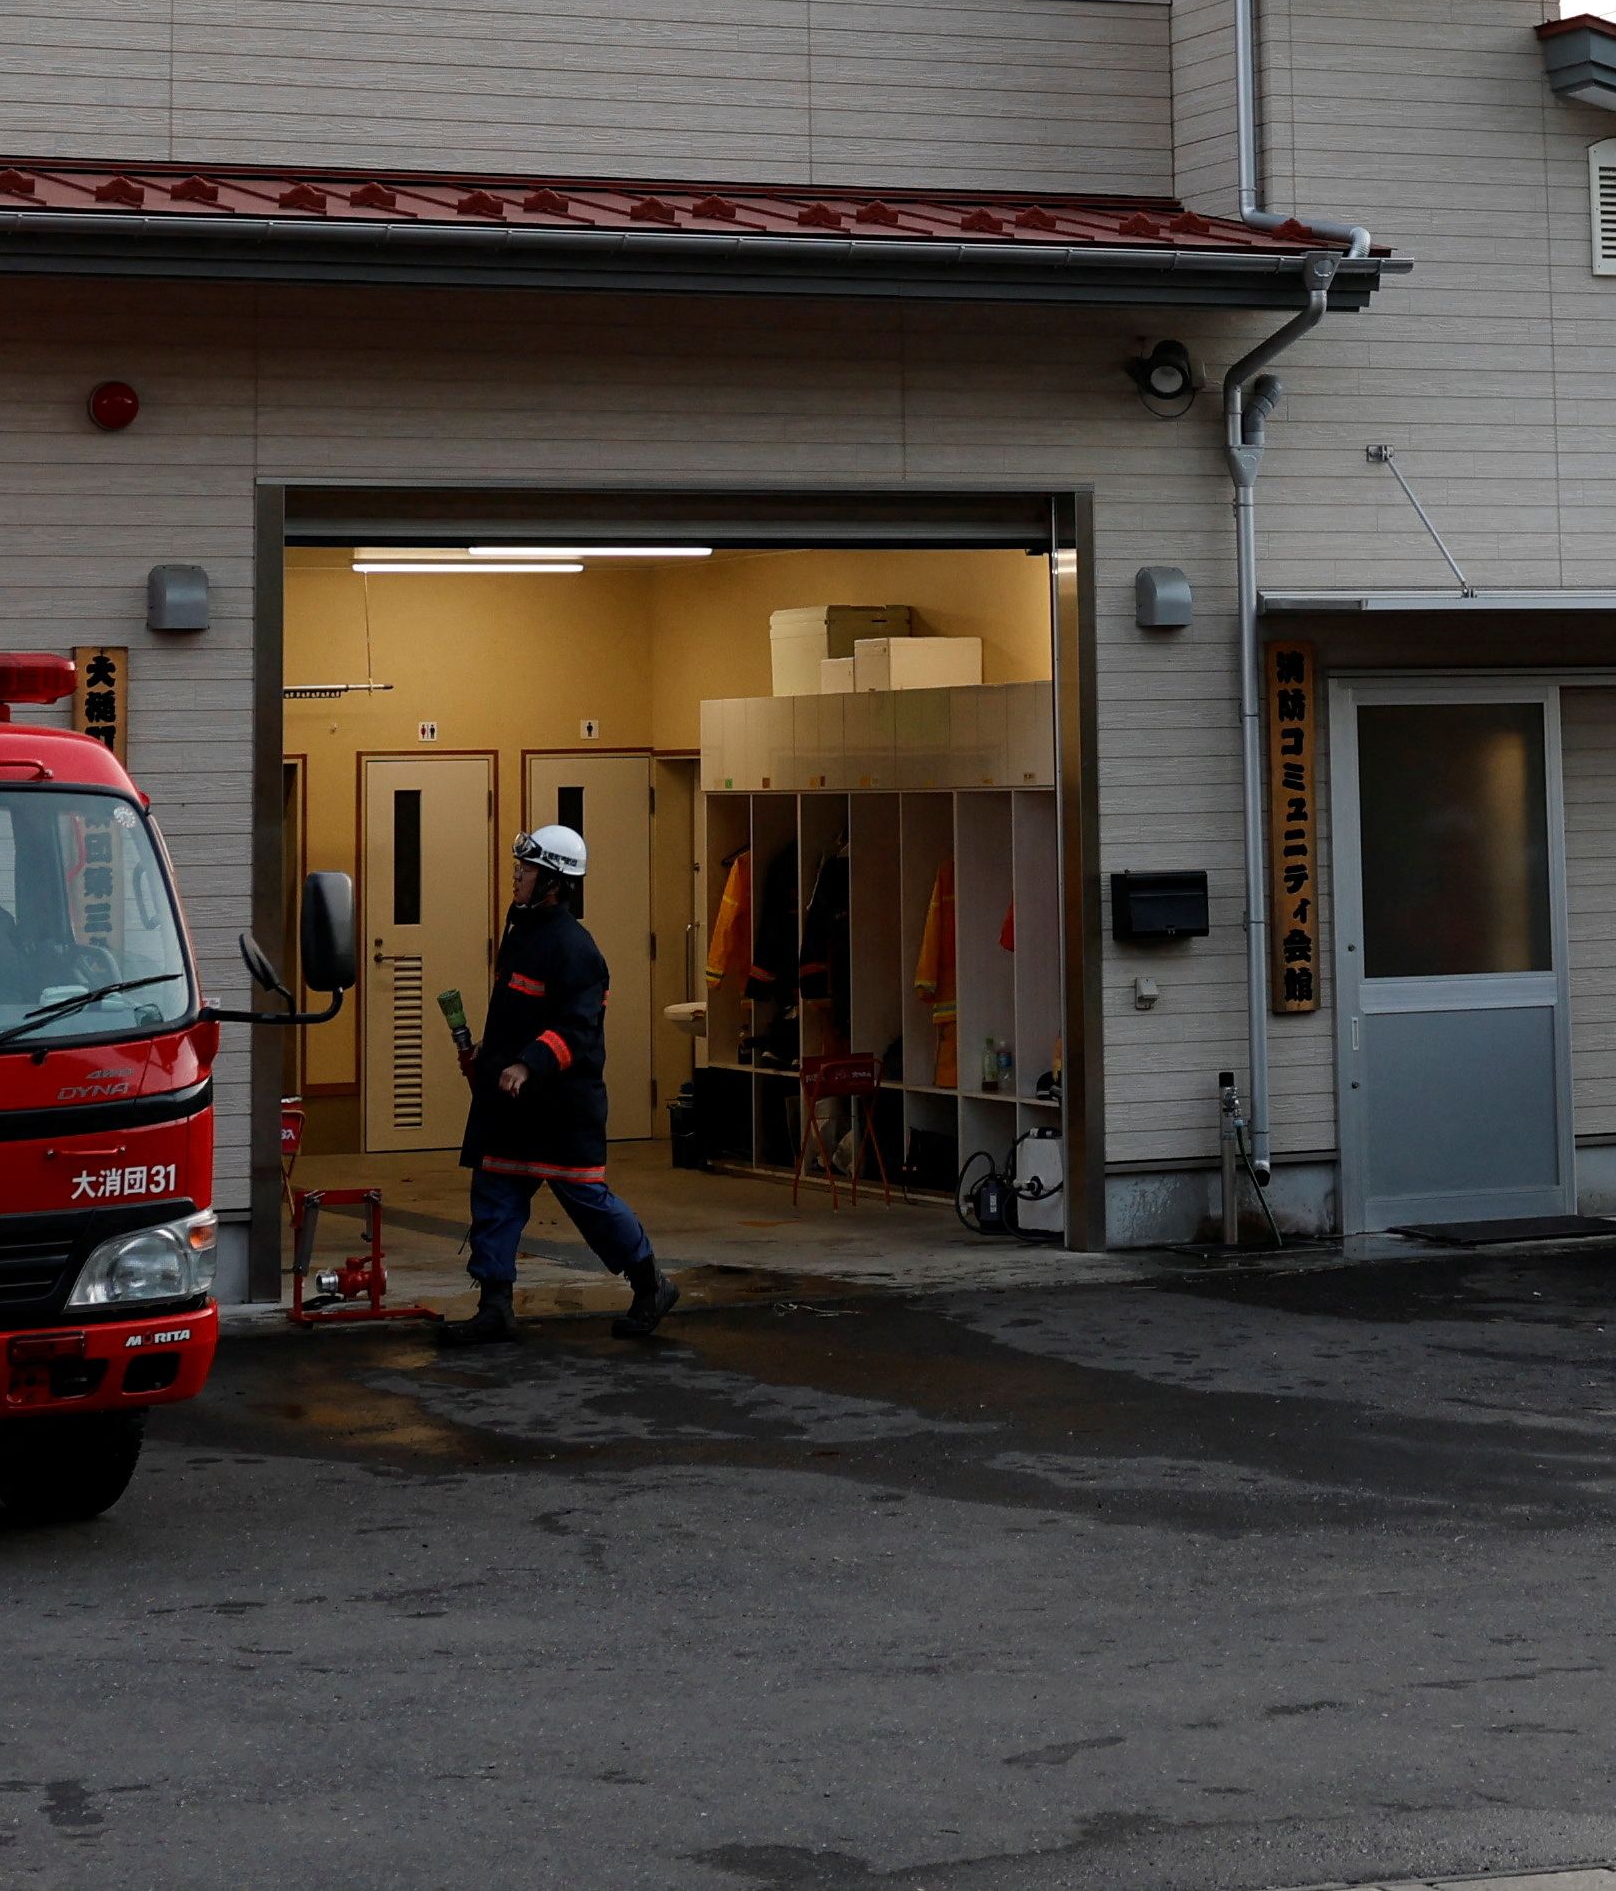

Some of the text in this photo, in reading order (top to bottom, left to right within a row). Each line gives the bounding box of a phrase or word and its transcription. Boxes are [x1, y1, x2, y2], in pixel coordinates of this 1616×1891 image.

[57, 1082, 130, 1101] DYNA
[70, 1164, 177, 1201] 大消団31
[125, 1329, 192, 1348] MORITA
